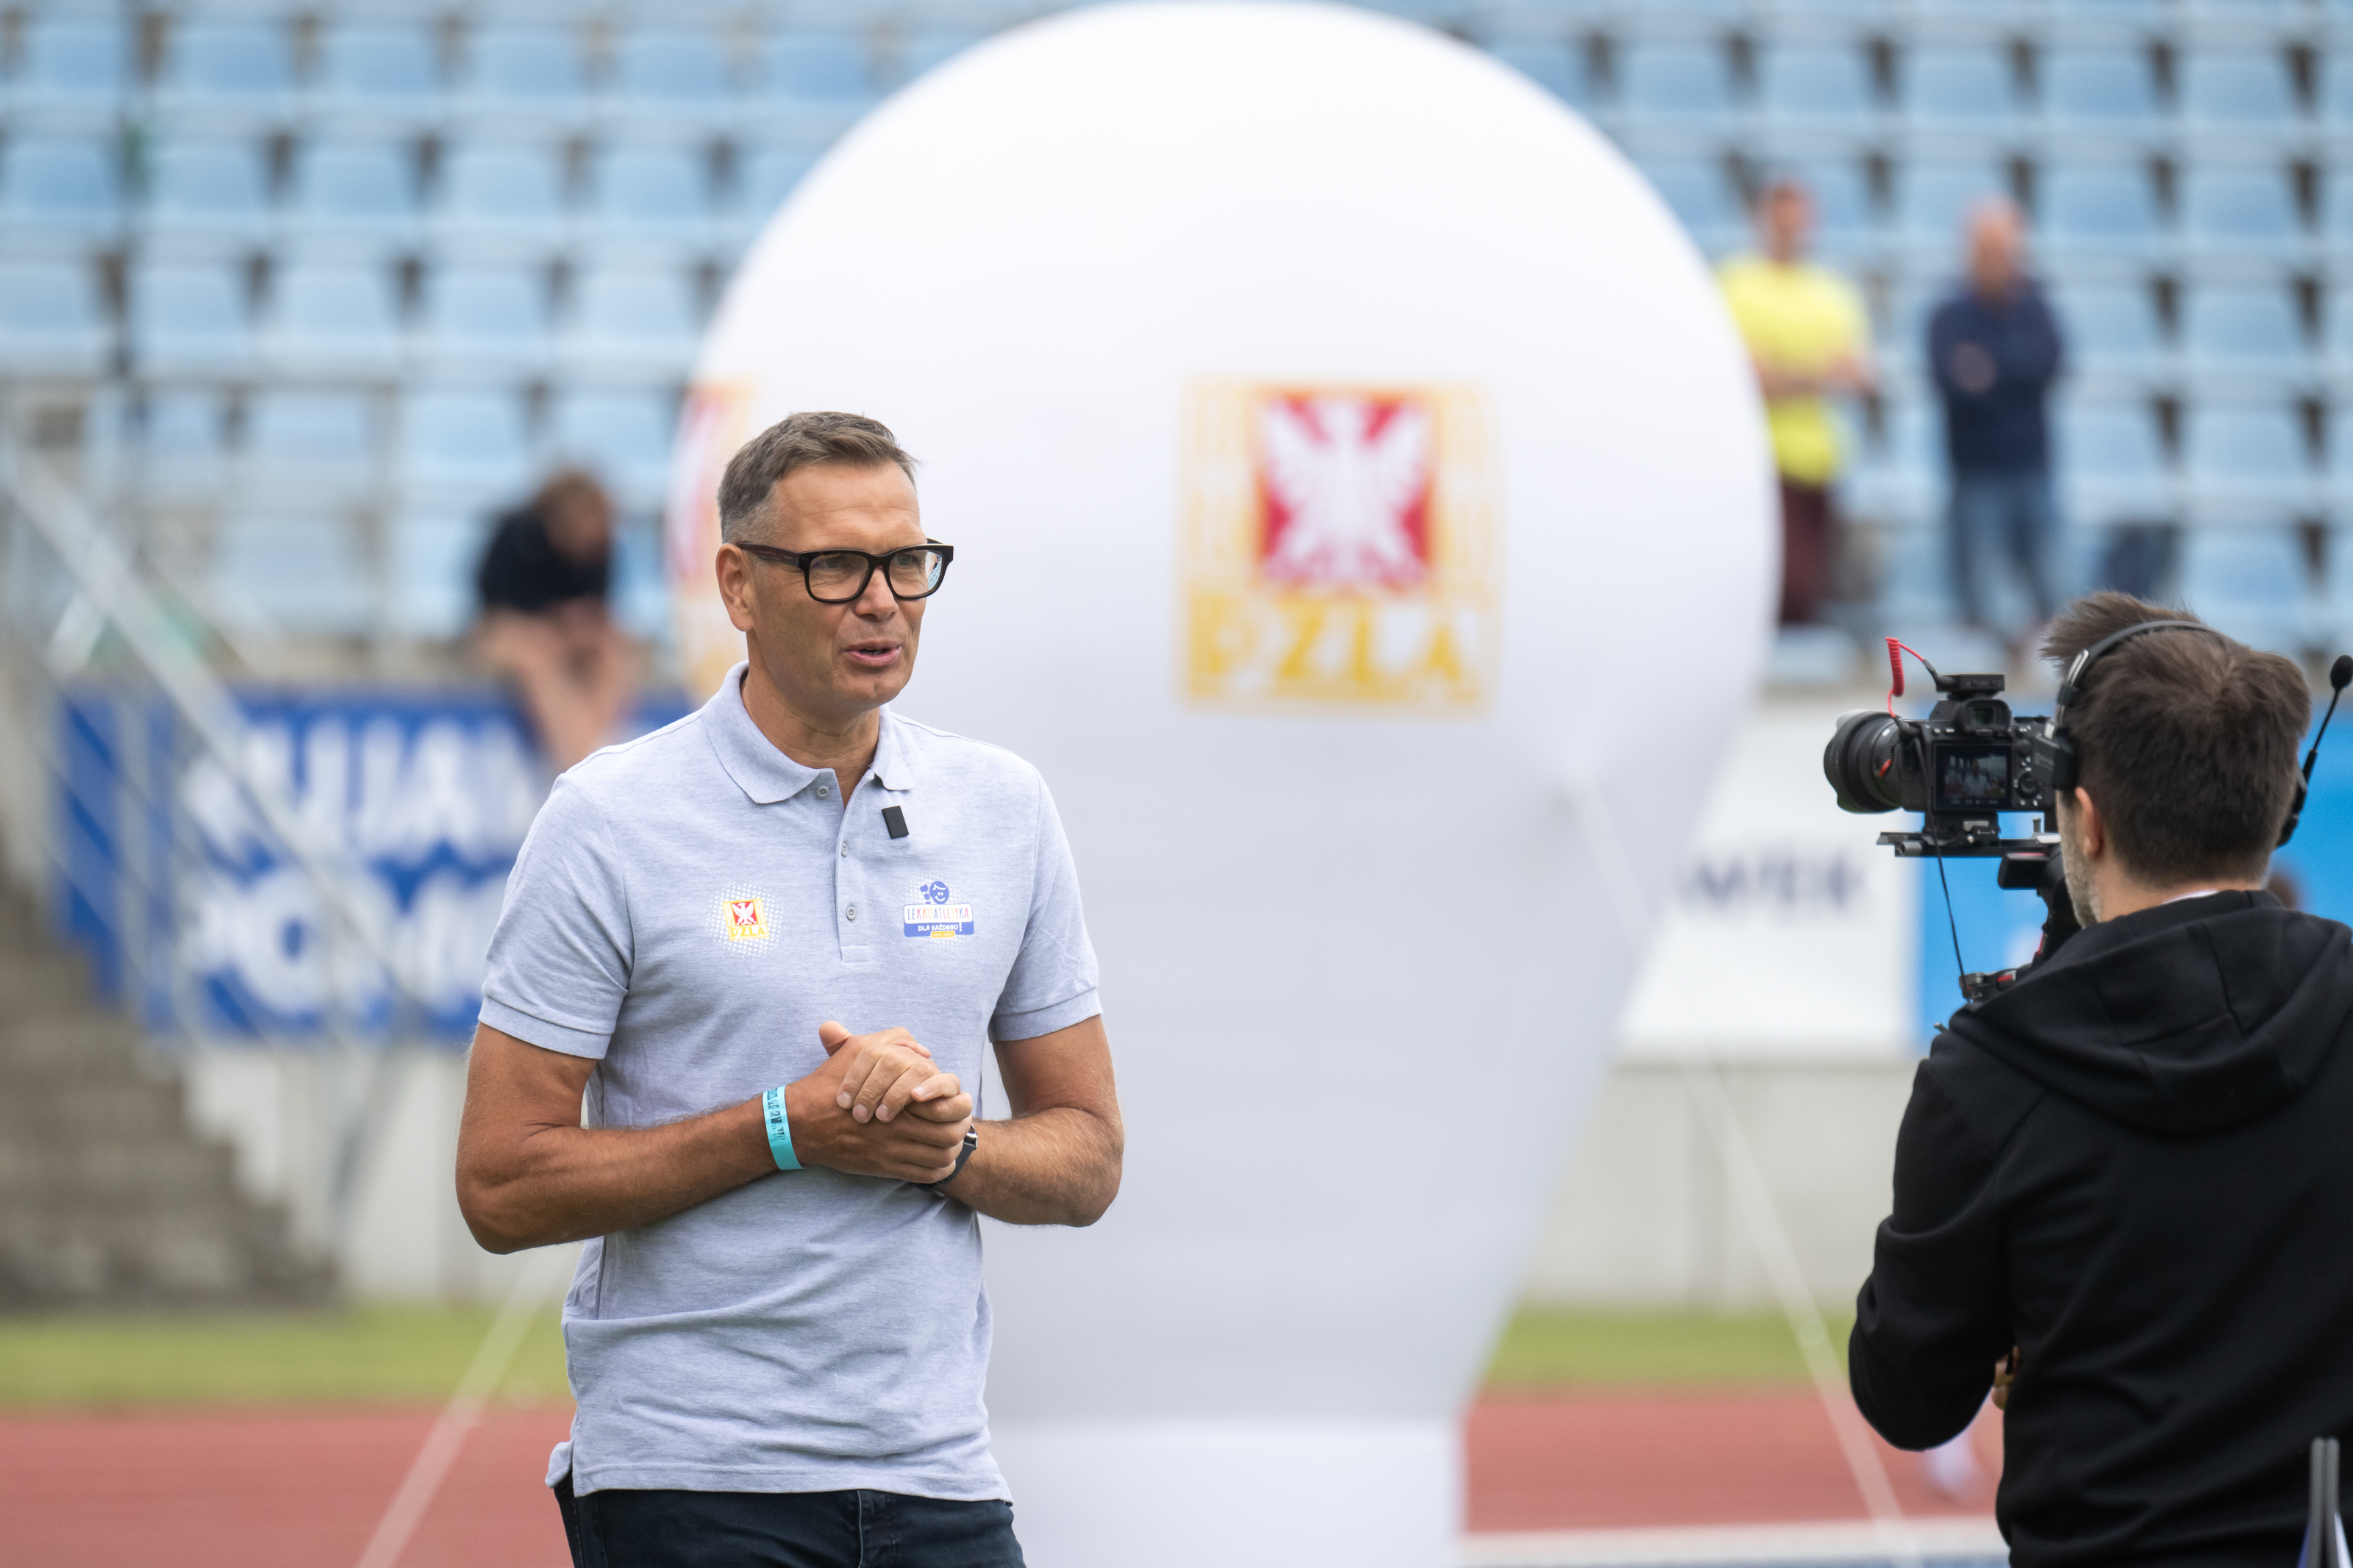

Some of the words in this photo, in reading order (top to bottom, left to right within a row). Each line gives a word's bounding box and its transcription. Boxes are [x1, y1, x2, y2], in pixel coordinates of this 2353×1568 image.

[1186, 594, 1479, 701] PZLA
[907, 907, 969, 920] LEKKOATLETYKA
[730, 926, 766, 939] PZLA
